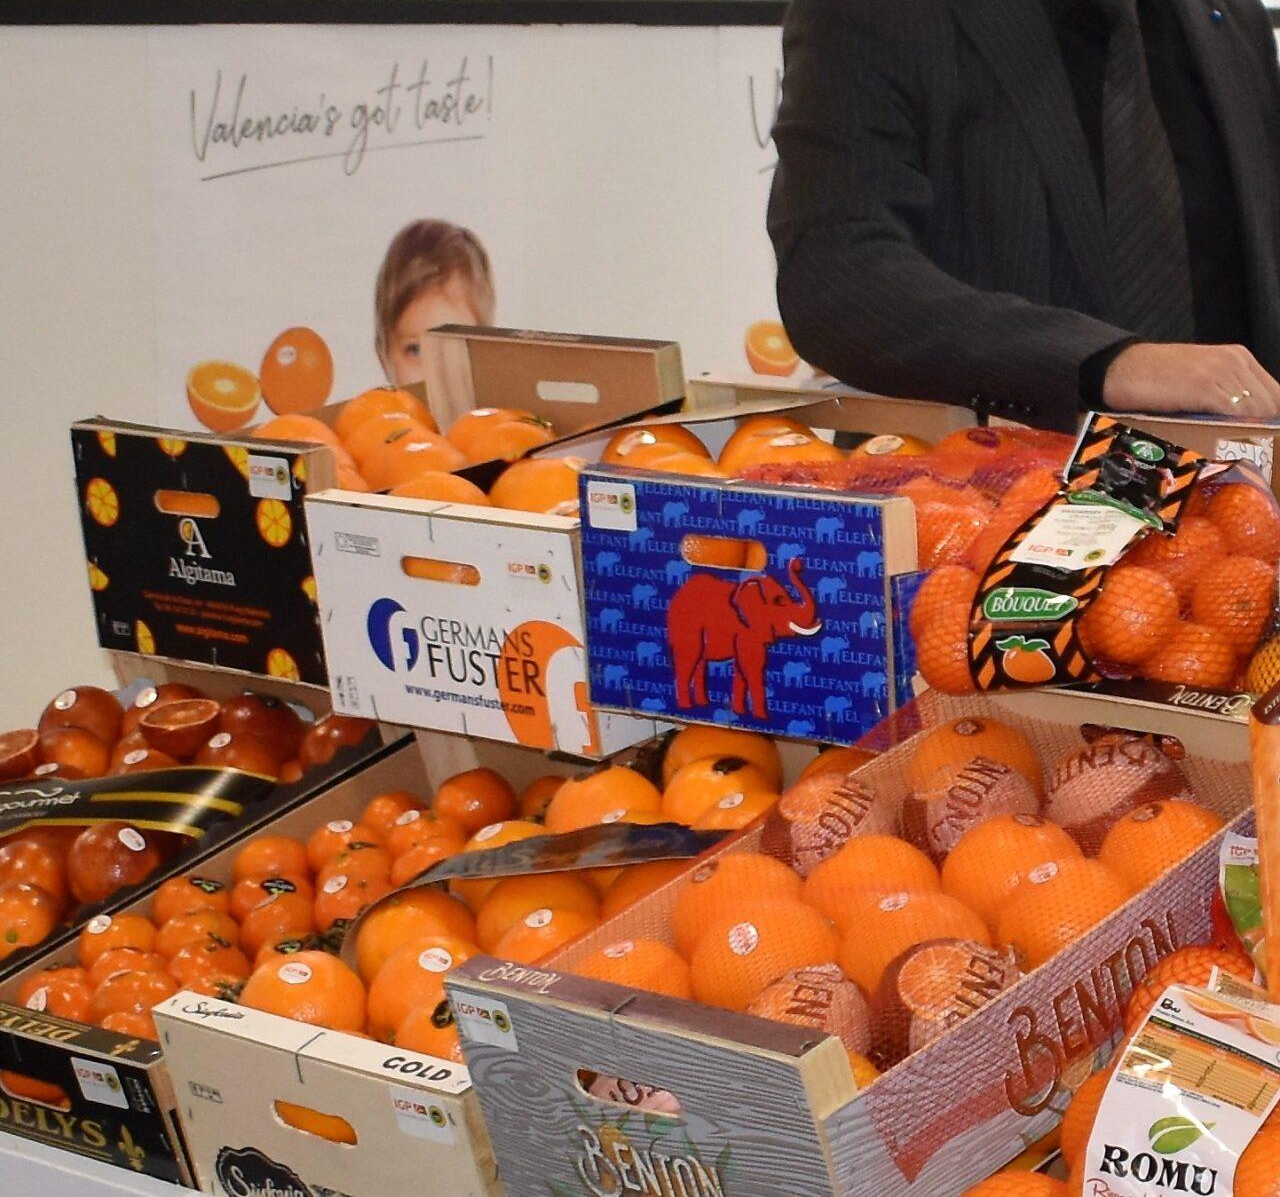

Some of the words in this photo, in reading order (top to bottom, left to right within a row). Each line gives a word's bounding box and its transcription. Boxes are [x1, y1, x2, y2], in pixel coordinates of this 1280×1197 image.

[190, 68, 341, 162] Valencia's
[344, 62, 402, 176] got
[406, 55, 494, 130] taste!
[682, 515, 738, 531] ELEFANT
[758, 522, 815, 540] ELEFANT
[837, 530, 884, 547] ELEFA
[168, 557, 237, 587] Algitama
[805, 557, 855, 572] LEFANT
[615, 563, 665, 582] ELEFANT
[839, 589, 885, 607] ELEFA
[420, 615, 535, 658] GERMANS
[825, 618, 859, 634] FANT
[427, 643, 546, 698] FUSTER
[842, 650, 886, 667] ELEFA
[405, 684, 536, 717] www.germansfuster.com
[622, 678, 675, 696] ELEFANT
[804, 675, 863, 694] ELEFANT
[1166, 683, 1256, 717] BENTON
[767, 699, 825, 717] ELEFANT
[478, 961, 564, 995] BENTON
[457, 1002, 476, 1015] IGP
[1003, 909, 1184, 1118] BENTON
[382, 1056, 452, 1082] GOLD
[393, 1098, 412, 1111] IGP
[577, 1125, 725, 1197] BENTON
[1099, 1143, 1218, 1196] ROMU
